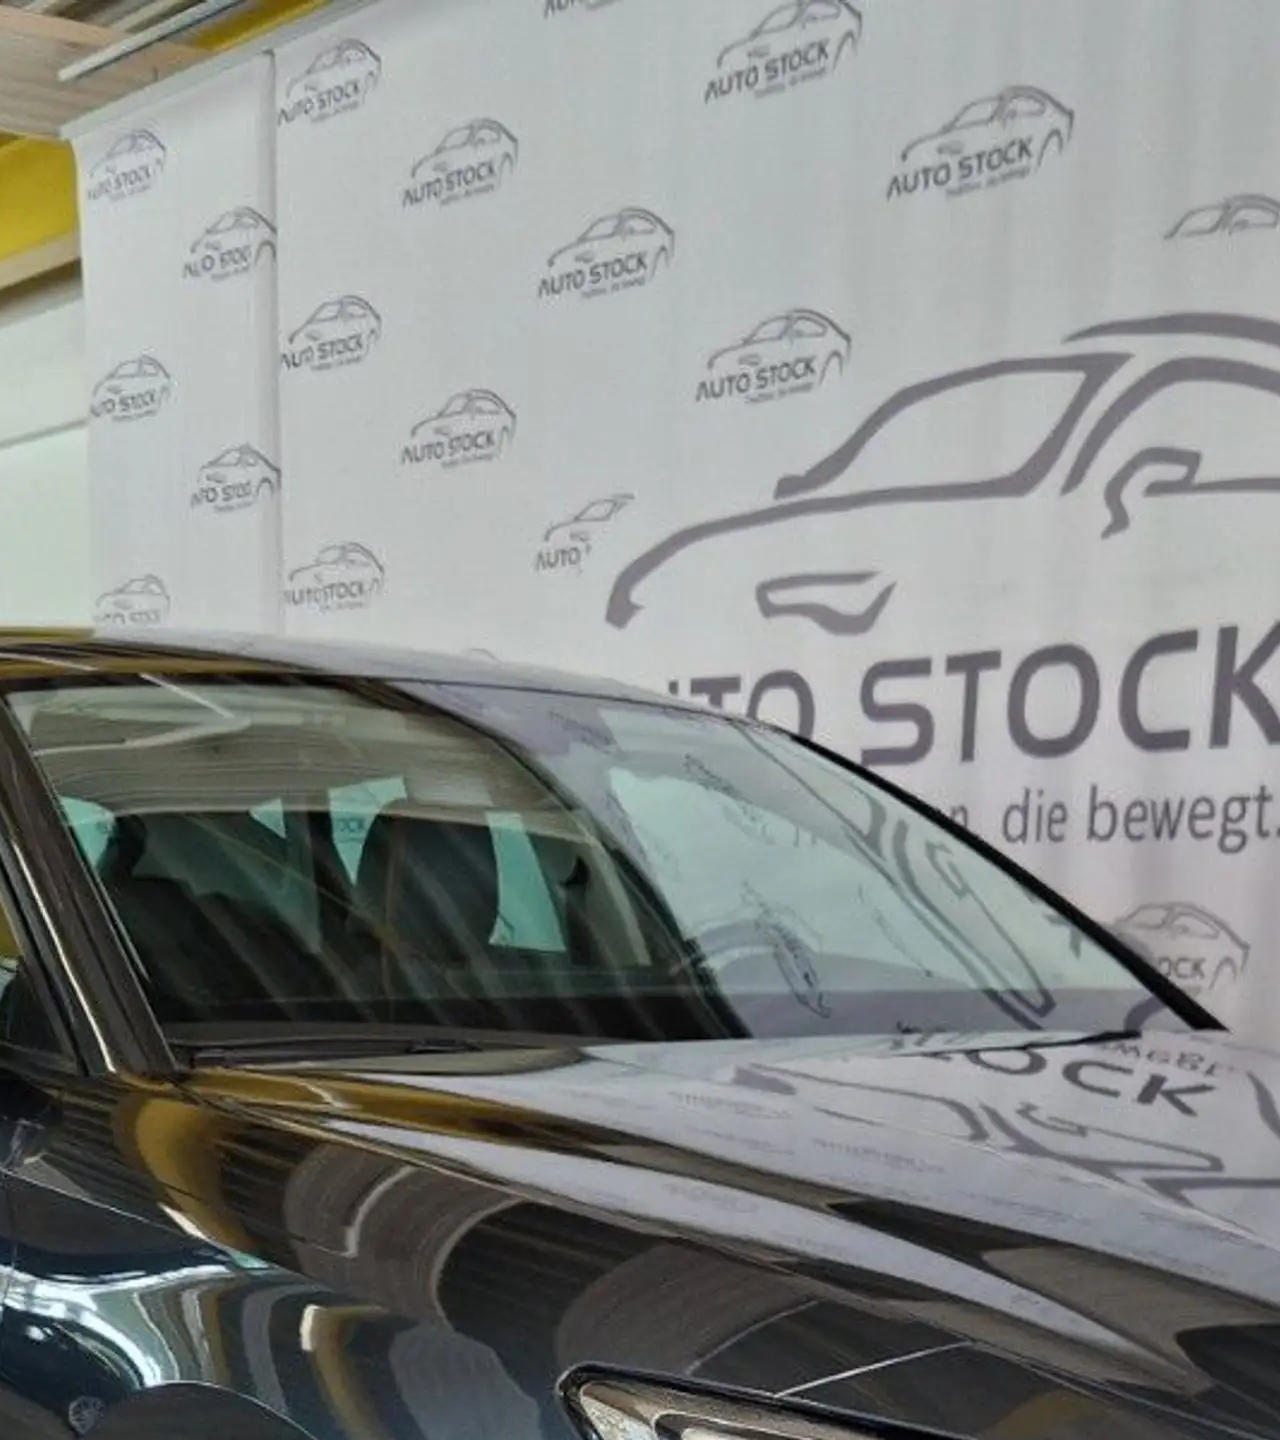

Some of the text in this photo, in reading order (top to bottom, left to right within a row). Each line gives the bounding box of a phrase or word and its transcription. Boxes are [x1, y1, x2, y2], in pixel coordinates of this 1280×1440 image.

[705, 66, 759, 104] AUTO
[764, 38, 831, 81] STOCK
[402, 178, 443, 207] AUTO
[445, 160, 497, 192] STOCK
[886, 162, 951, 203] AUTO
[957, 135, 1033, 180] STOCK
[537, 268, 586, 298] AUTO
[589, 252, 648, 285] STOCK
[695, 371, 751, 402] AUTO
[755, 356, 816, 390] STOCK
[401, 441, 445, 465] AUTO
[447, 429, 496, 457] STOCK
[534, 546, 581, 572] AUTO
[1001, 787, 1069, 845] die
